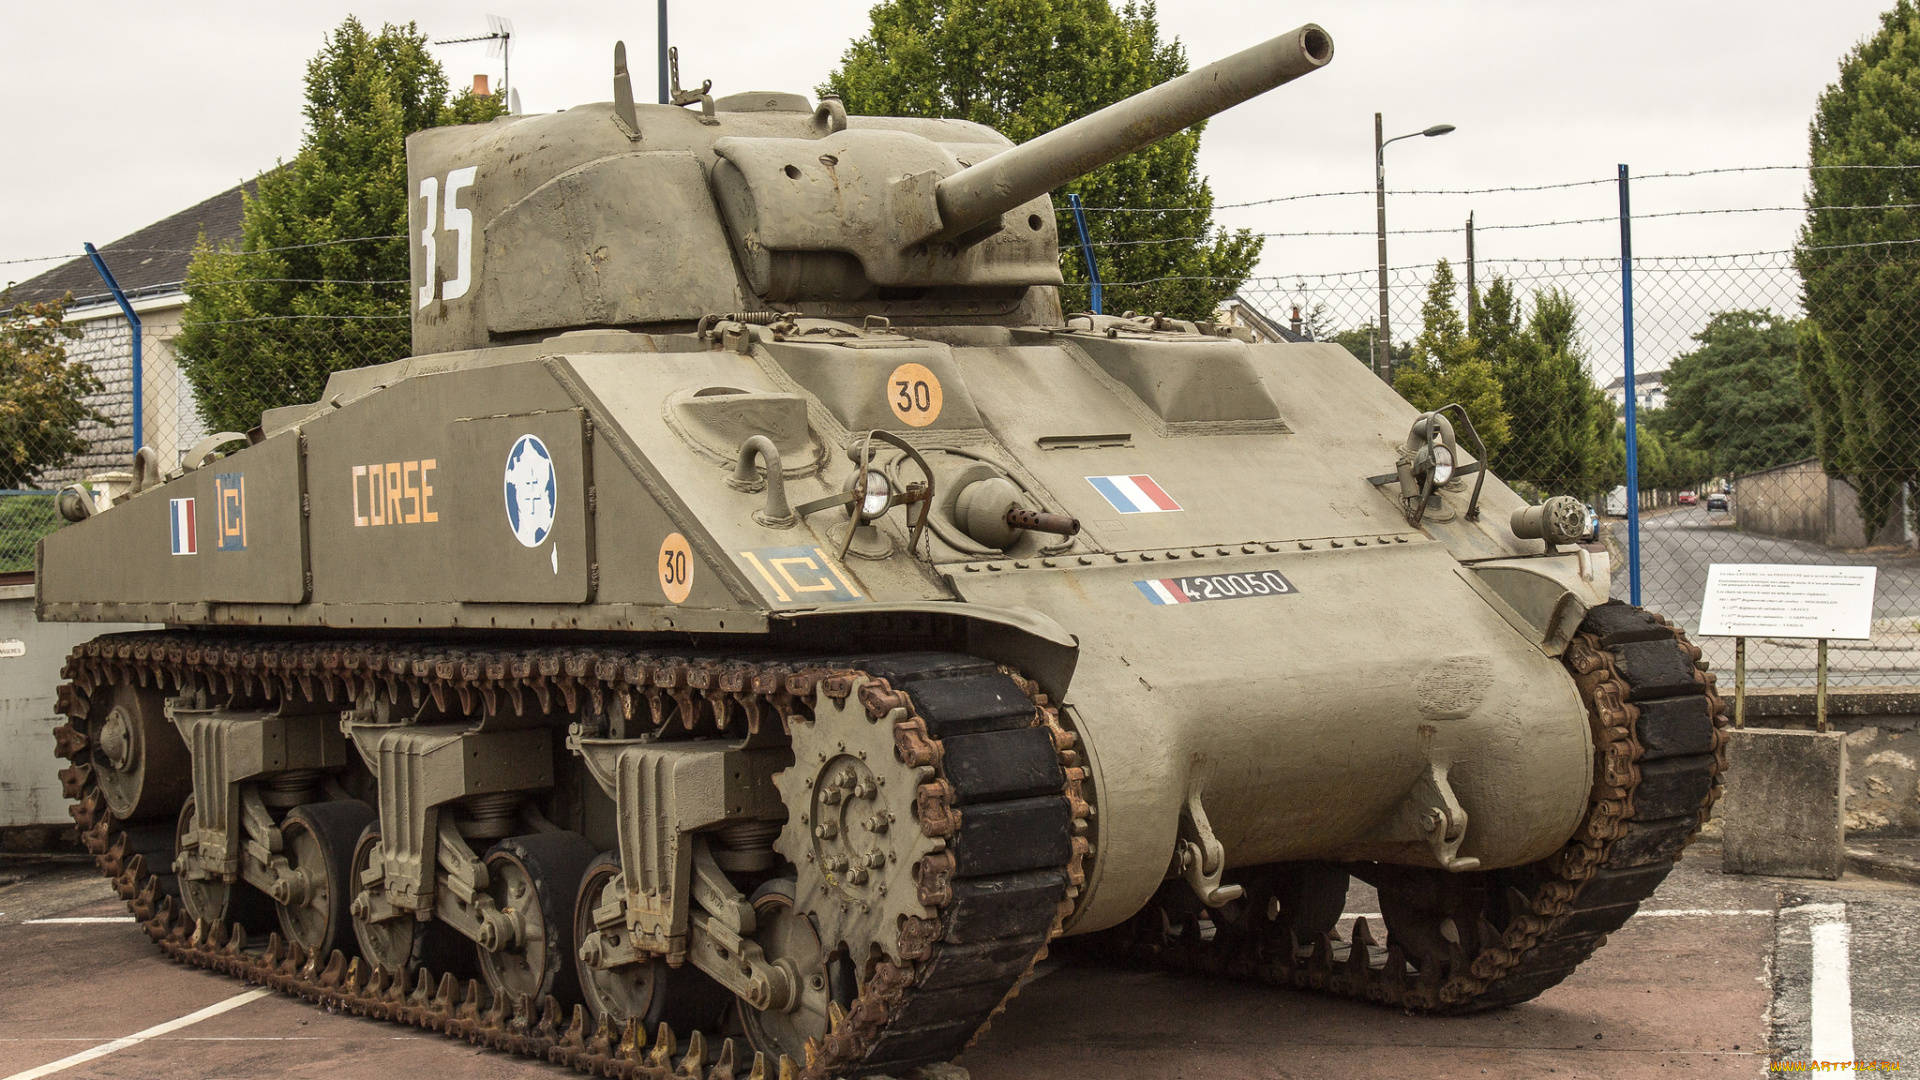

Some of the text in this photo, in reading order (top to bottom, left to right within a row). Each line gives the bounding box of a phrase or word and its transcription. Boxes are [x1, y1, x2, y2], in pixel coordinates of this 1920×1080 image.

[419, 166, 478, 310] 35
[895, 380, 931, 412] 30
[352, 459, 438, 526] CORSE
[664, 550, 686, 585] 30
[1180, 571, 1289, 600] 420050
